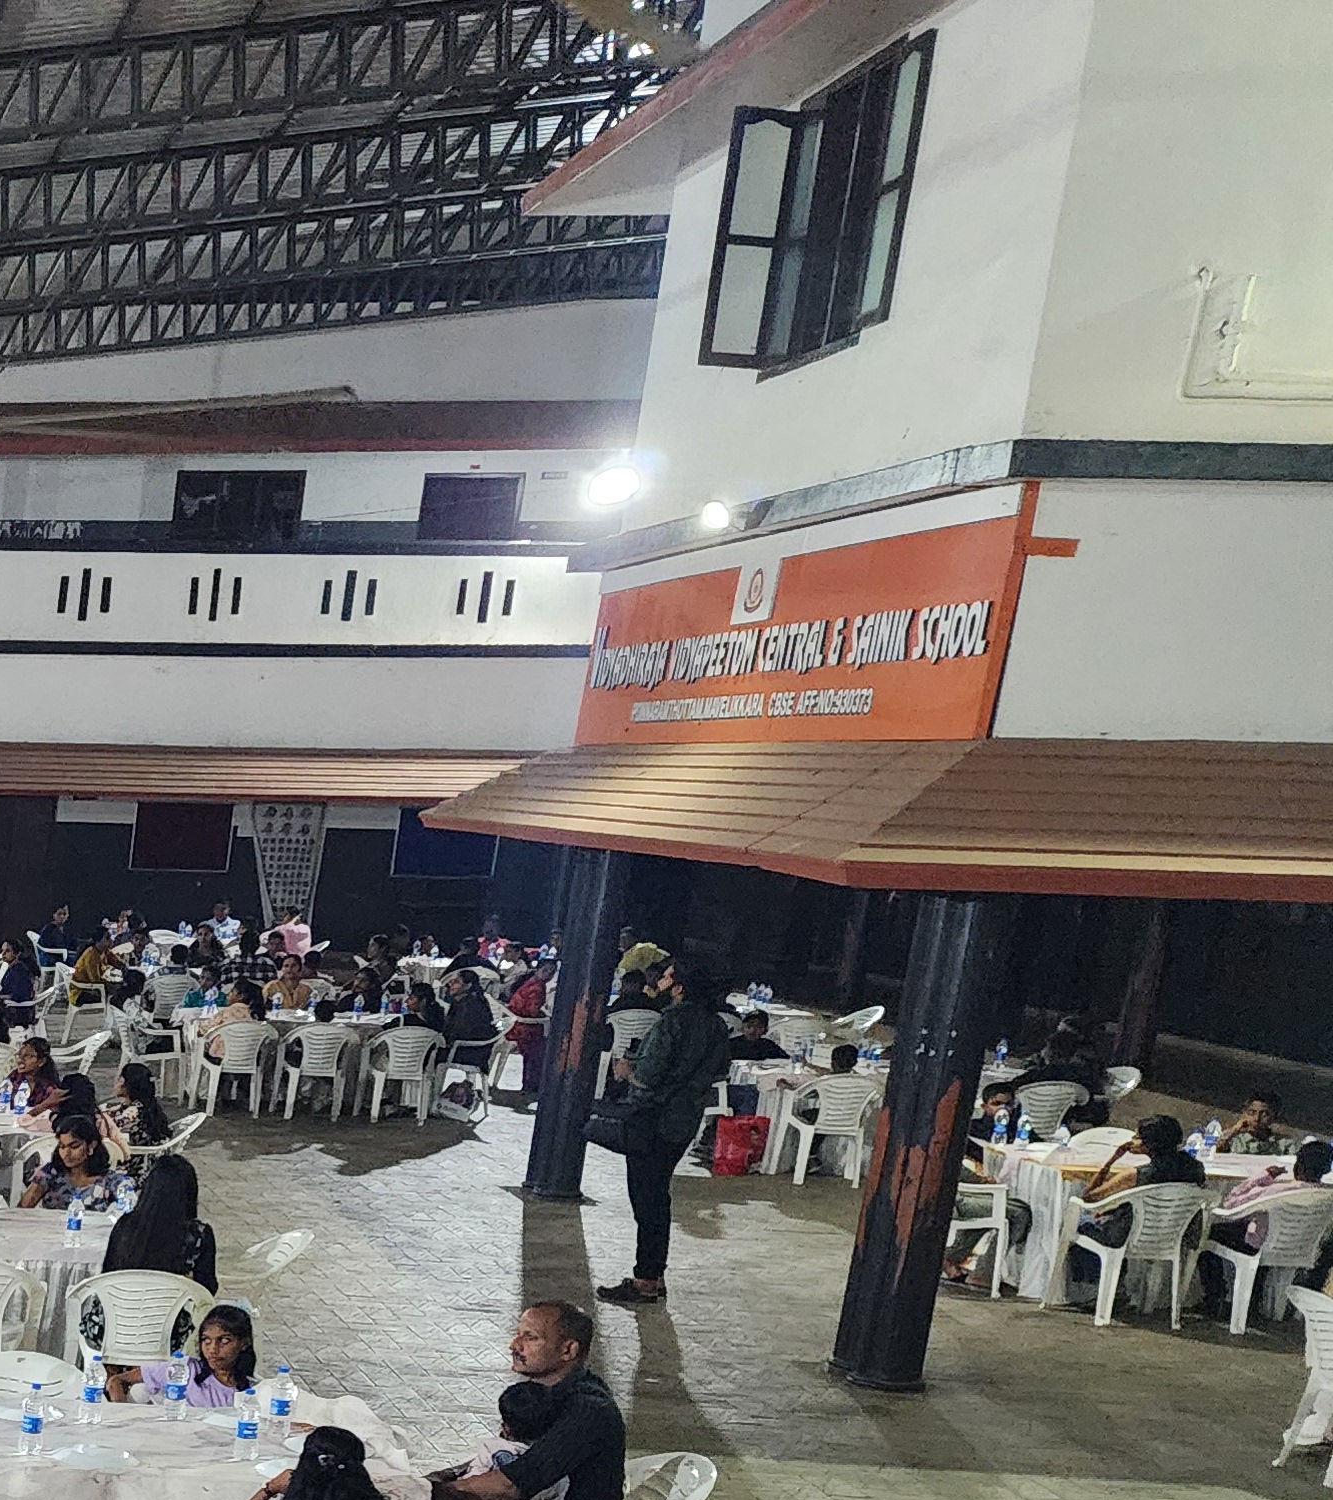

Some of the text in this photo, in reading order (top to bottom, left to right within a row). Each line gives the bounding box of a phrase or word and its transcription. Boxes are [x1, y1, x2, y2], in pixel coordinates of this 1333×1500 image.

[759, 620, 828, 675] CENTRAL
[847, 607, 916, 670] SAINIK
[912, 599, 993, 665] SCHOOL
[767, 690, 795, 718] CBSE
